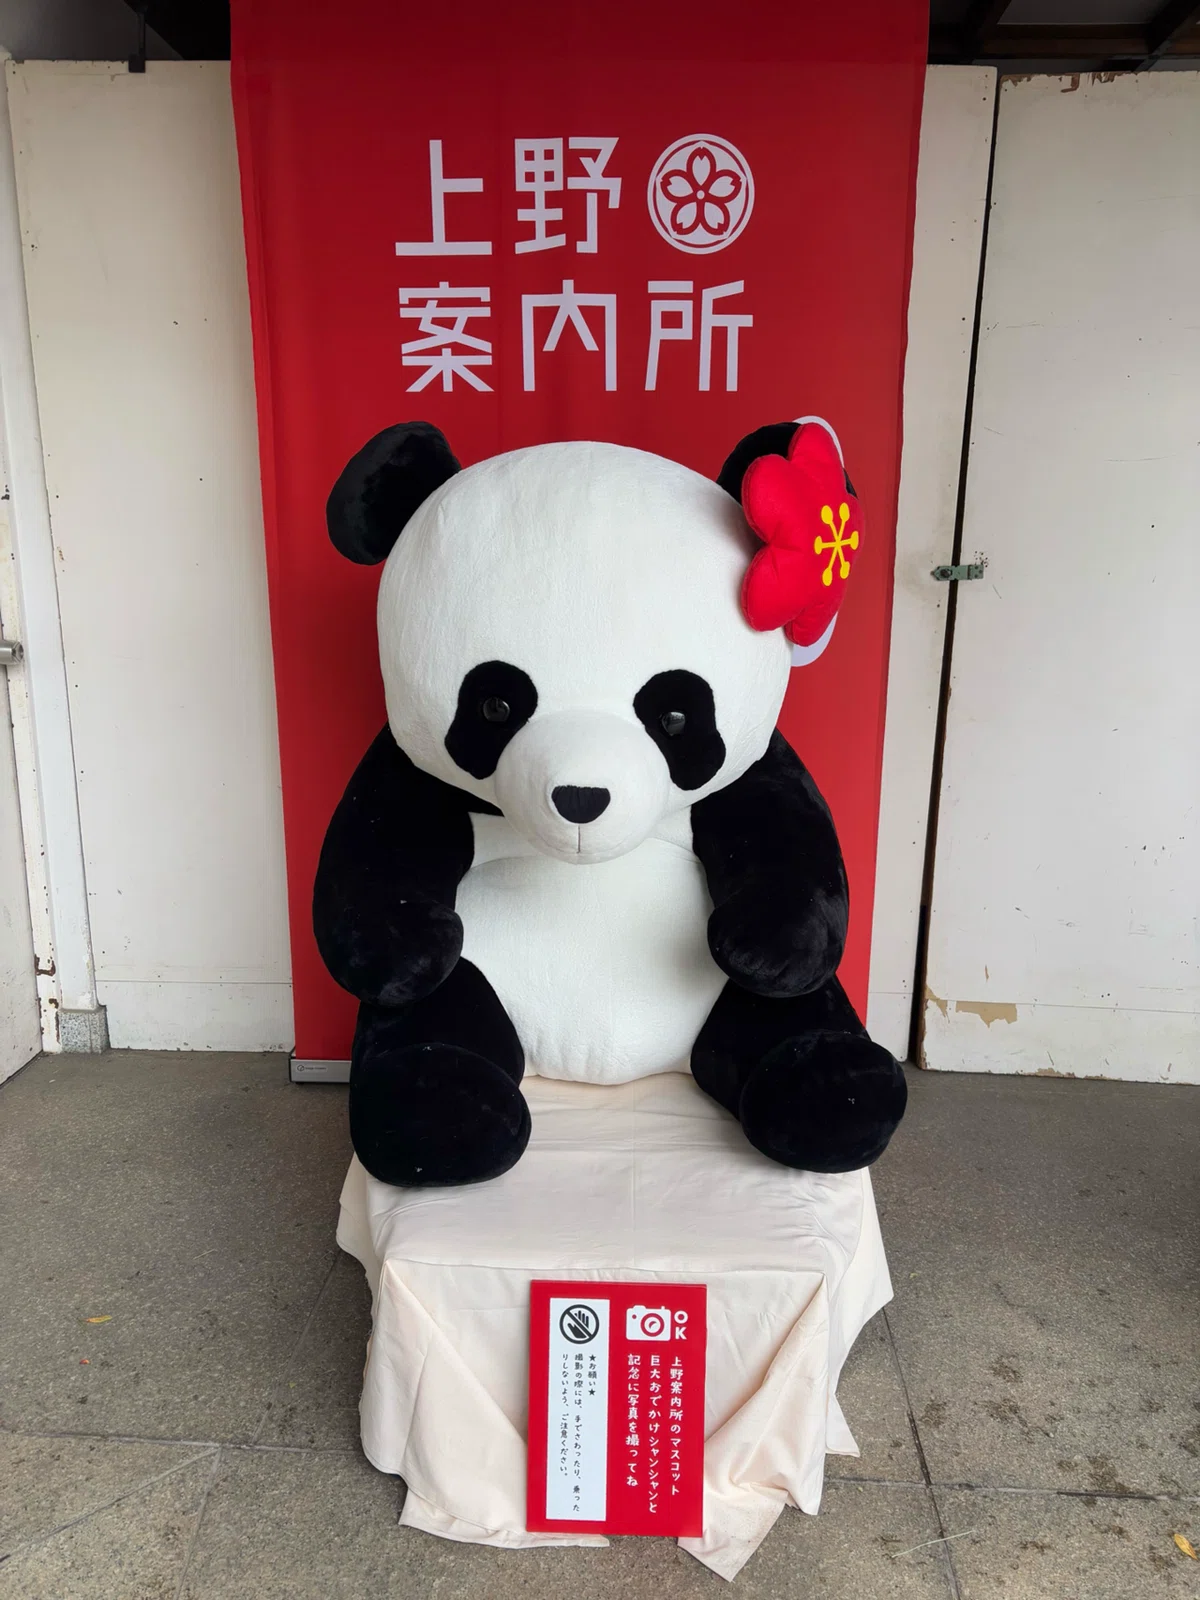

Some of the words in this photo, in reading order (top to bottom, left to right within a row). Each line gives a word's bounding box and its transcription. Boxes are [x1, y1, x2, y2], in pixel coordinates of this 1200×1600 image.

[395, 136, 622, 257] 上野
[398, 279, 754, 393] 案内所
[625, 1353, 641, 1487] 記念に写真を撮ってね
[648, 1354, 662, 1514] 巨大おでかけシャンシャンと
[668, 1355, 684, 1496] 上野案内所のマスコット
